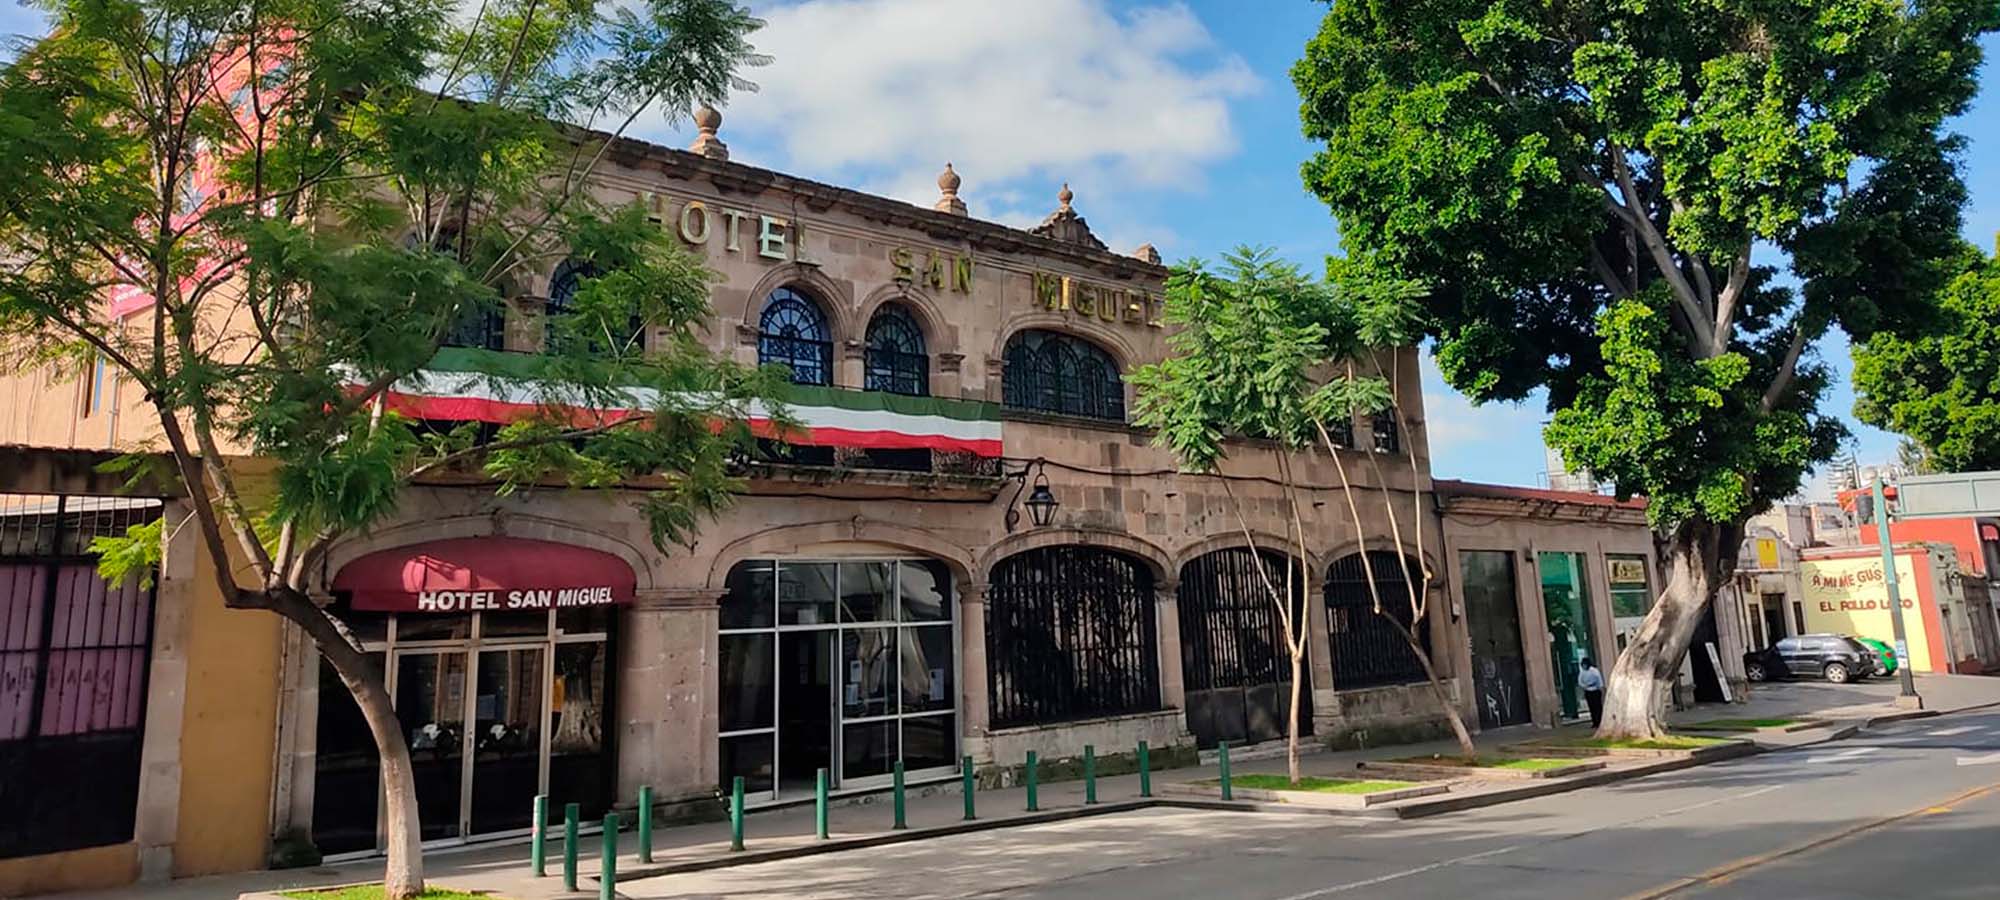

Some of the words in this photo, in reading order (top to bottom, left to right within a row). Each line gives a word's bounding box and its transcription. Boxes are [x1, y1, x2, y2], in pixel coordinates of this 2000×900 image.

[889, 246, 975, 295] SAN
[1031, 269, 1165, 329] MIGUEL
[418, 591, 500, 610] HOTEL
[507, 590, 552, 608] SAN
[556, 586, 613, 607] MIGUEL
[1819, 600, 1836, 612] EL
[1840, 599, 1877, 611] POLLO
